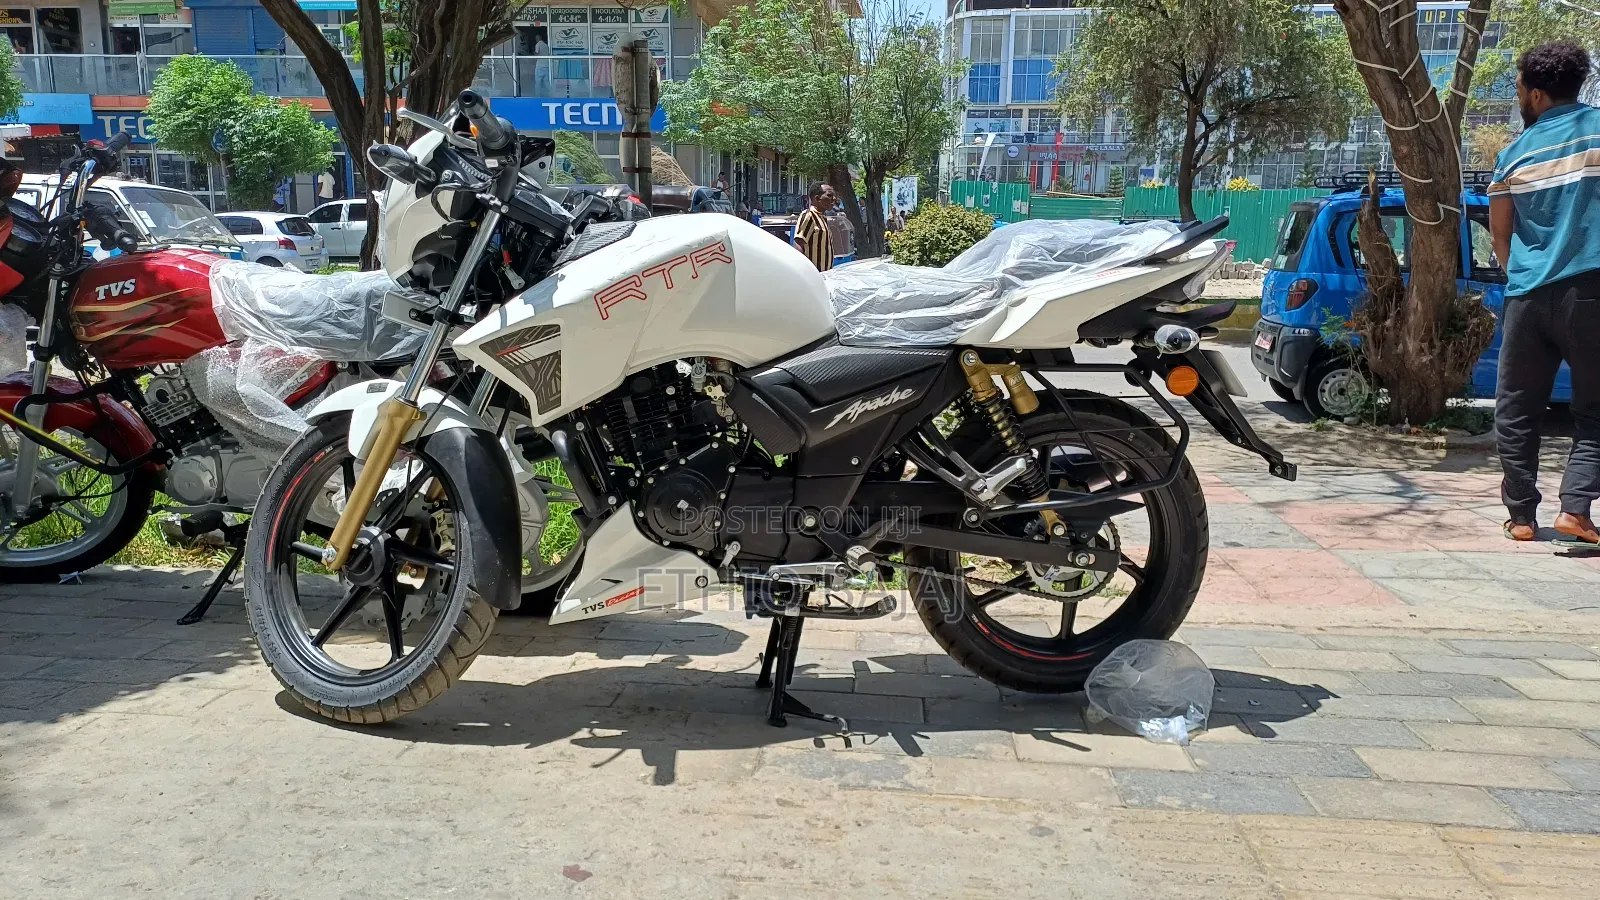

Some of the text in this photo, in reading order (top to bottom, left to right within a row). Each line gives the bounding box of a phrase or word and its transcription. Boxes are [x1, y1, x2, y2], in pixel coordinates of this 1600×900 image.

[541, 102, 623, 125] TECN
[97, 115, 153, 139] TEC
[95, 278, 136, 301] TVS
[594, 241, 732, 320] RTR
[824, 385, 916, 430] Apache
[581, 602, 605, 614] TVS
